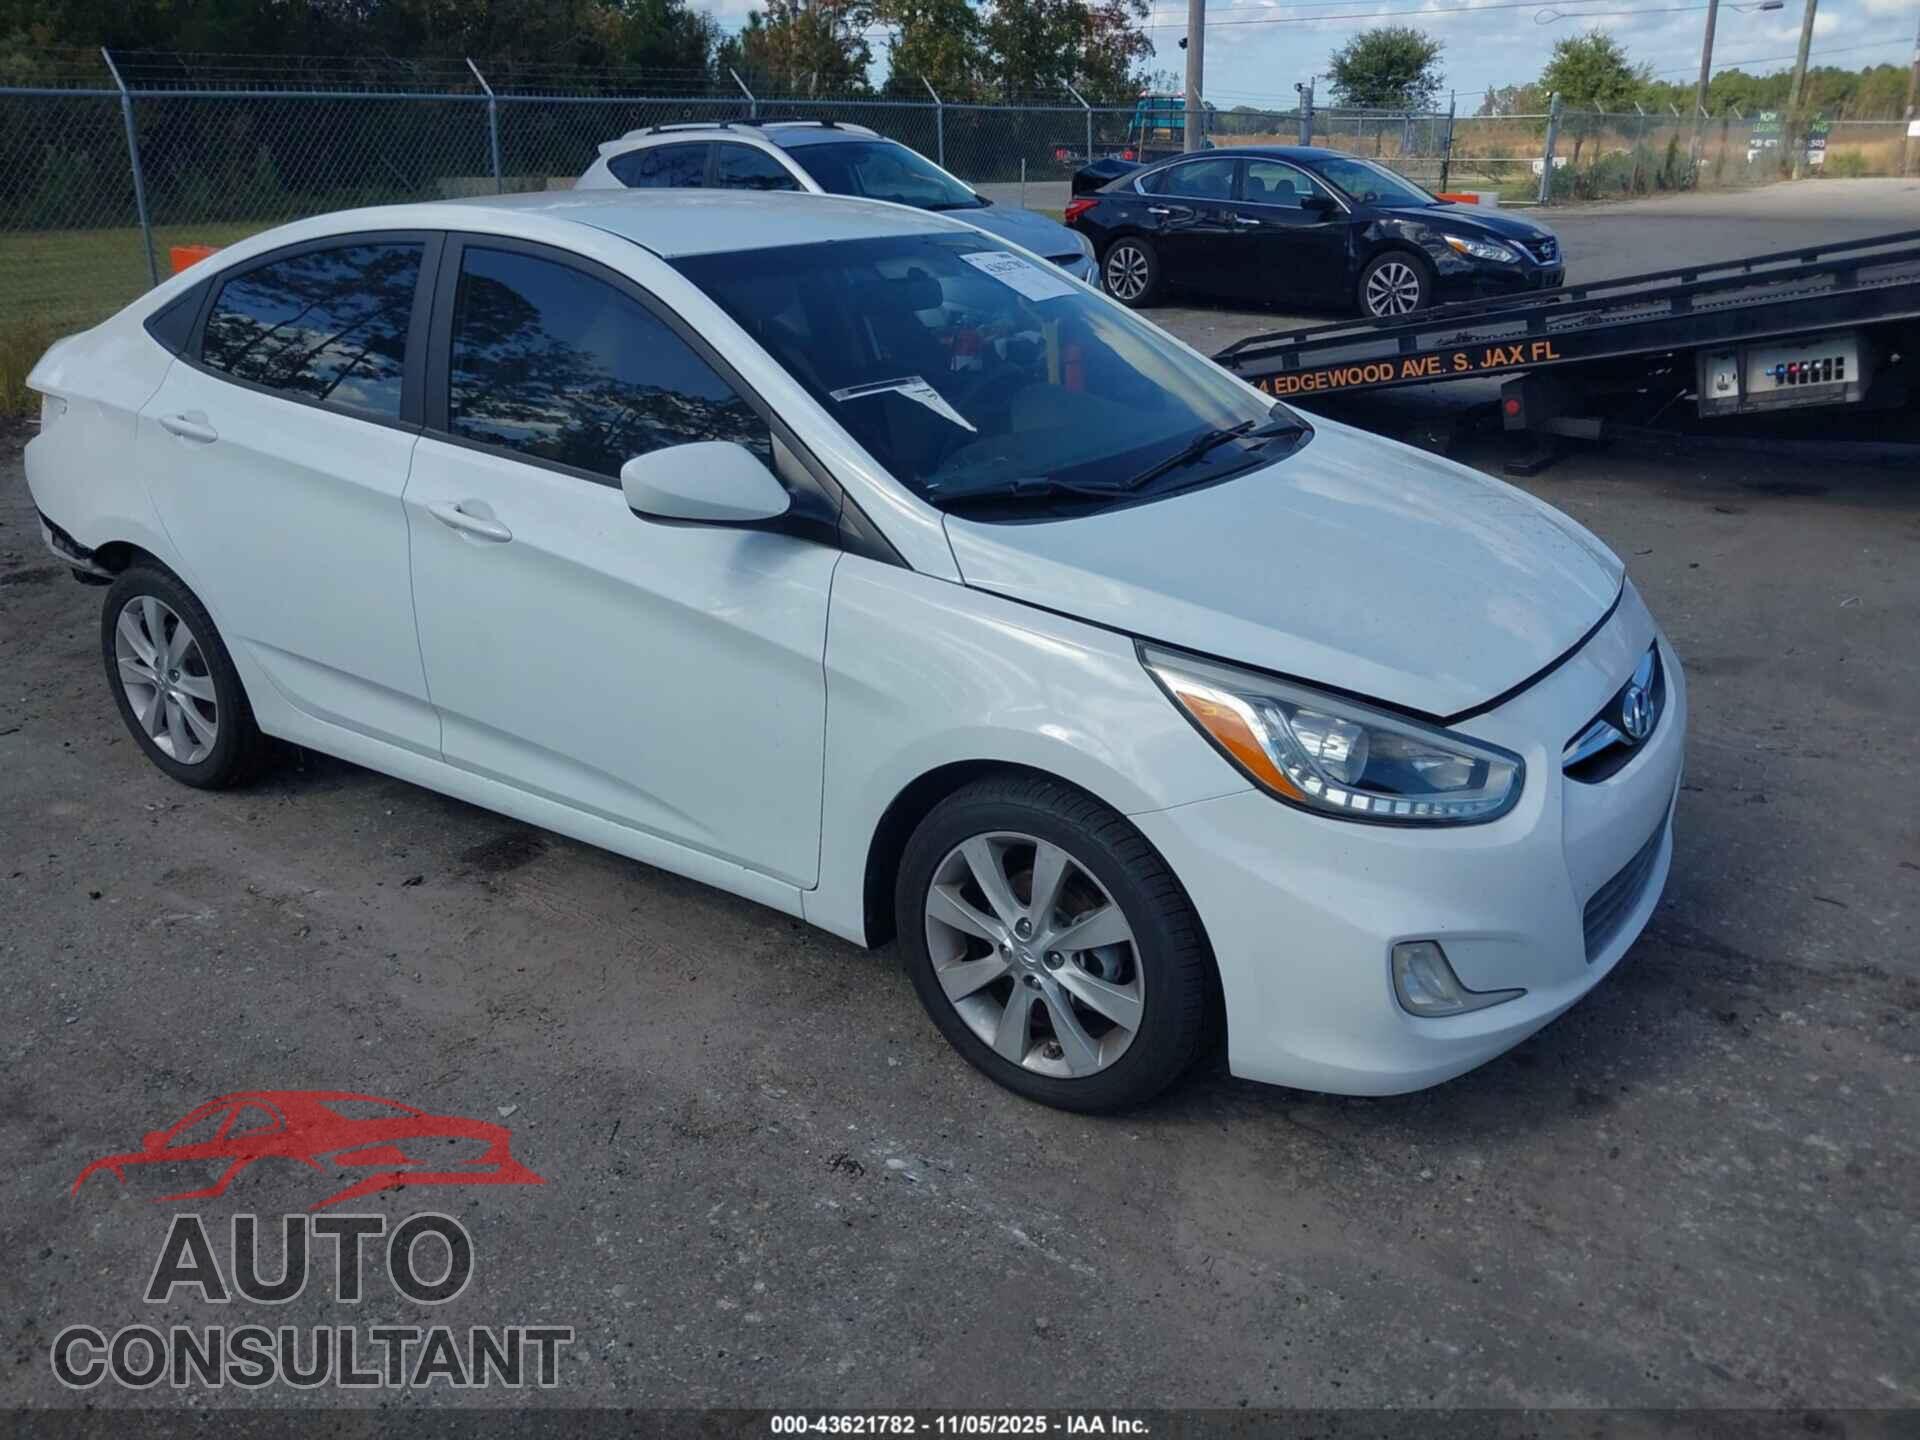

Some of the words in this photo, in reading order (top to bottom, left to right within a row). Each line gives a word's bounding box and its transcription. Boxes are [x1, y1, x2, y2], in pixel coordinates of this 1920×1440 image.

[1275, 363, 1394, 394] EDGEWOOD
[1401, 356, 1447, 378] AVE.
[1453, 352, 1473, 371] S.
[1480, 344, 1524, 368] JAX
[1531, 341, 1560, 361] FL
